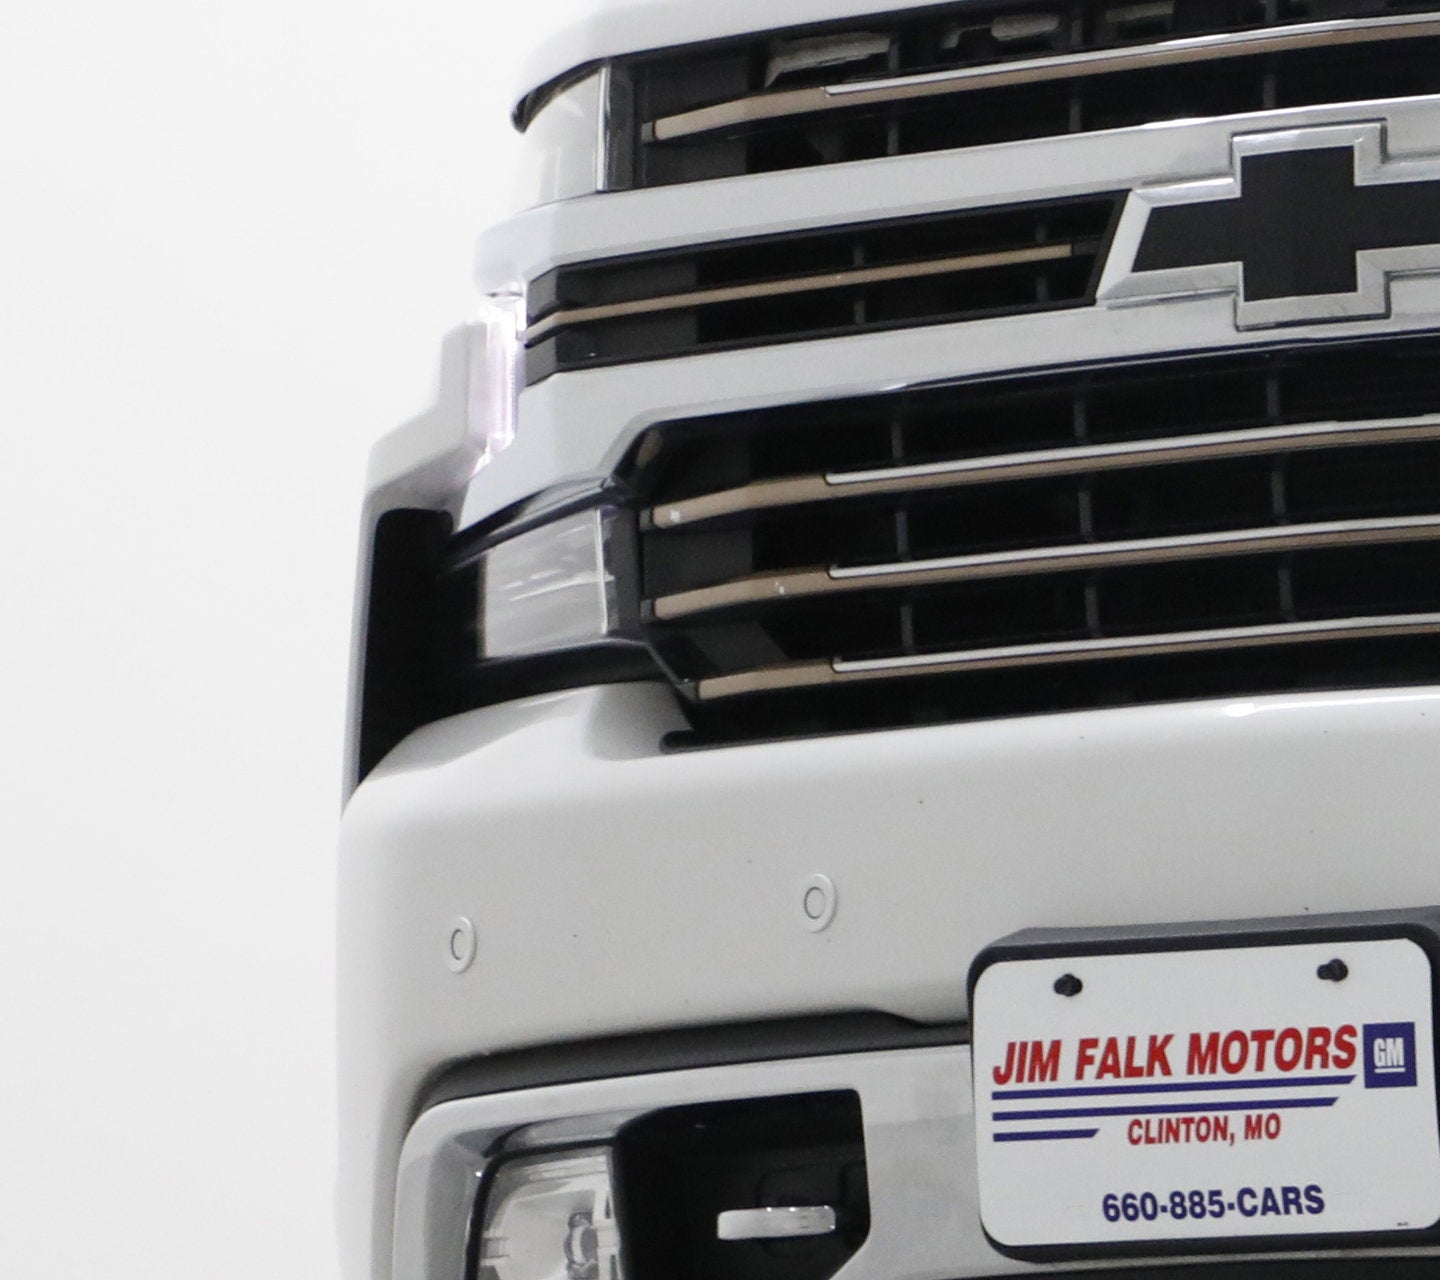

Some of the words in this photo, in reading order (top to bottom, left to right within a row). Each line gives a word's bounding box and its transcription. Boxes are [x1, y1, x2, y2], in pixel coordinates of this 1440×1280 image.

[993, 1039, 1062, 1086] JIM
[1075, 1034, 1173, 1081] FALK
[1187, 1024, 1358, 1075] MOTORS
[1373, 1036, 1405, 1067] GM
[1127, 1114, 1236, 1146] CLINTON,
[1244, 1113, 1281, 1140] MO
[1102, 1184, 1325, 1223] 660-885-CARS
